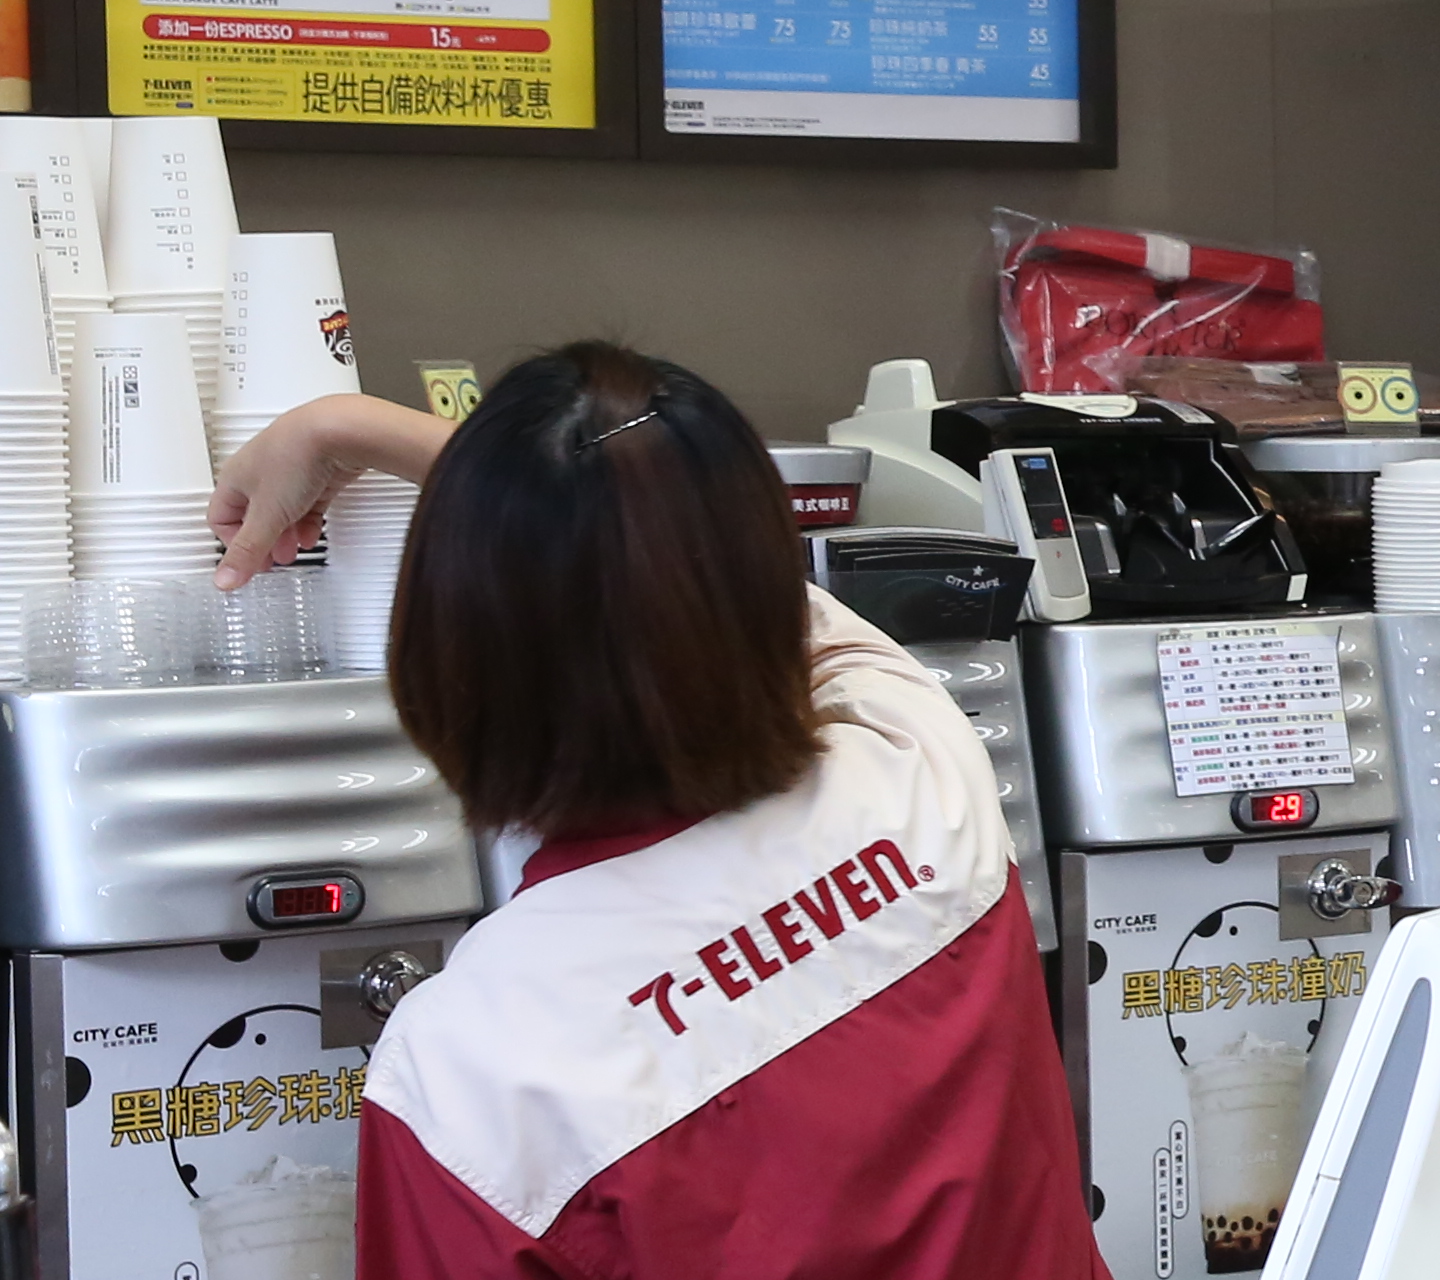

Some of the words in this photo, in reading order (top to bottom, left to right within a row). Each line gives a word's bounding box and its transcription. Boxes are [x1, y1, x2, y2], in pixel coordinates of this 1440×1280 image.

[978, 24, 998, 43] 55
[302, 71, 553, 119] 提供自備飲料杯優惠
[629, 837, 918, 1036] 7-ELEVEN
[1094, 917, 1124, 931] CITY
[1125, 913, 1158, 927] CAFE
[1122, 951, 1367, 1020] 黑糖珍珠撞奶
[73, 1028, 112, 1043] CITY
[115, 1023, 158, 1040] CAFE
